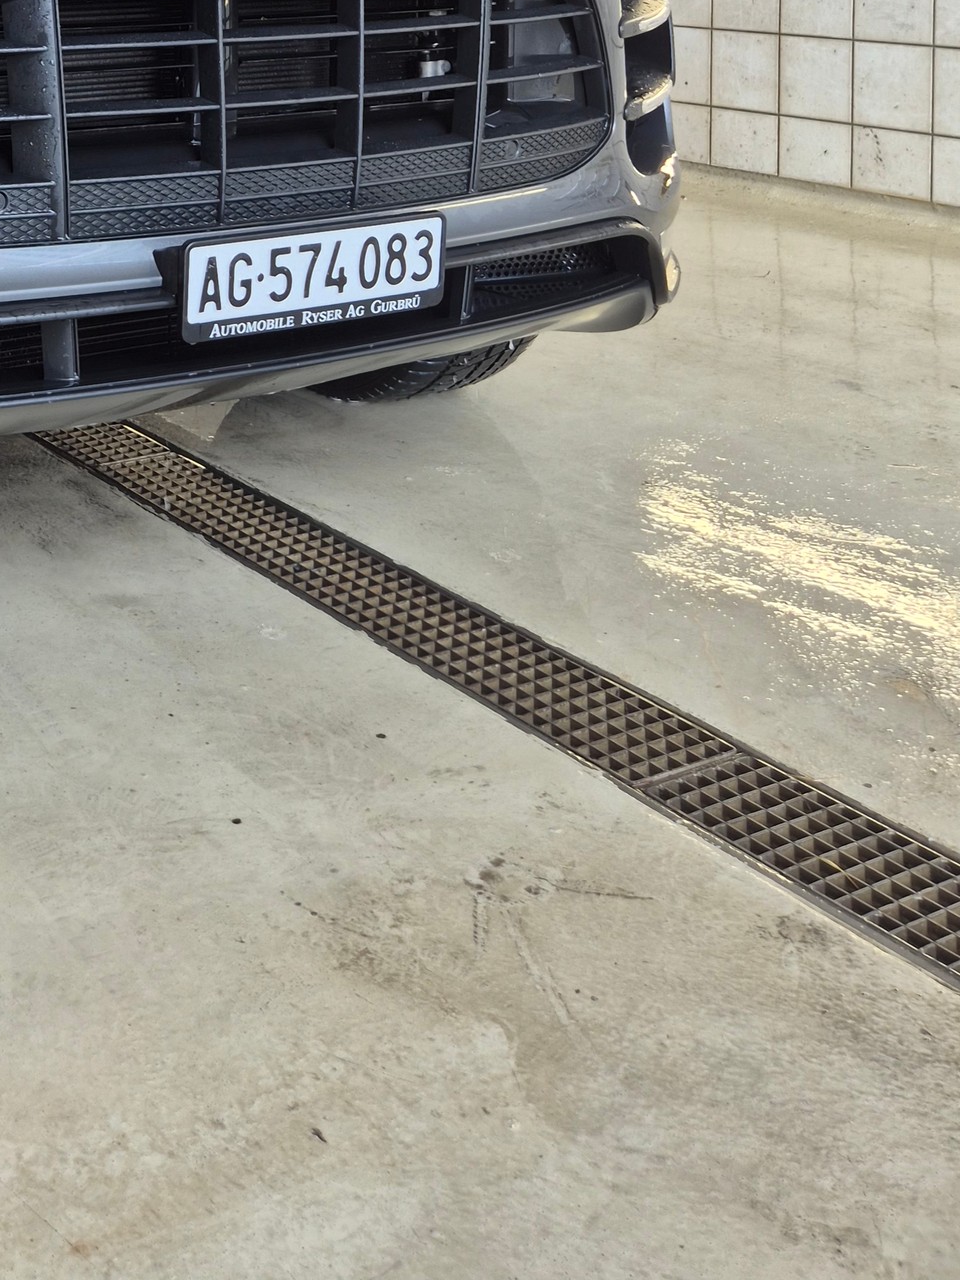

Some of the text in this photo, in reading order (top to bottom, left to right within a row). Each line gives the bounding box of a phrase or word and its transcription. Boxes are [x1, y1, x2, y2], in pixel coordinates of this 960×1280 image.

[209, 316, 295, 338] AUTOMOBILE
[301, 309, 343, 325] RYSER
[346, 304, 365, 319] AG
